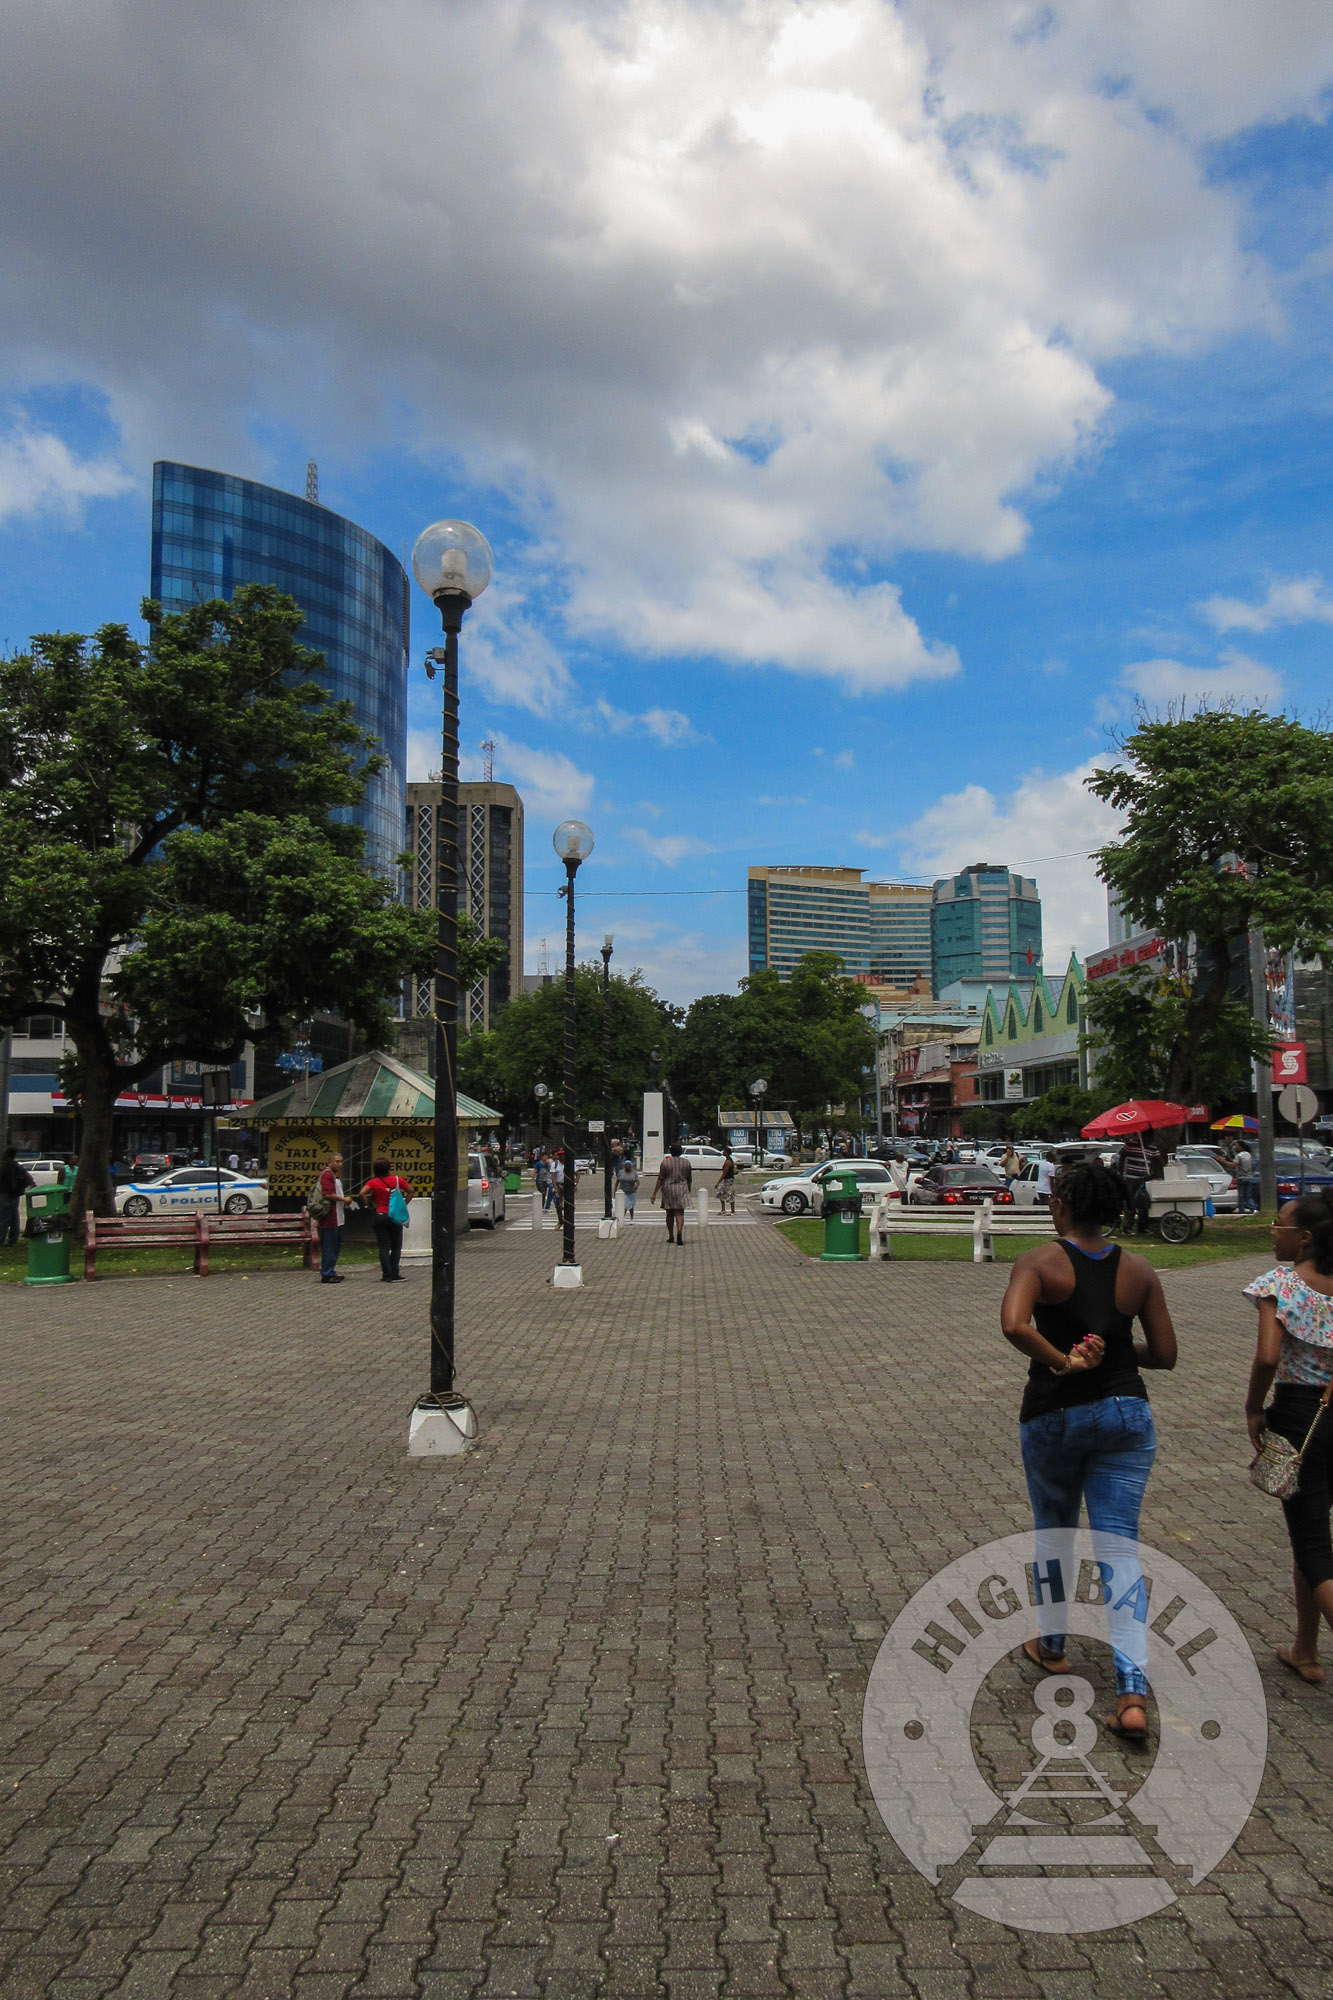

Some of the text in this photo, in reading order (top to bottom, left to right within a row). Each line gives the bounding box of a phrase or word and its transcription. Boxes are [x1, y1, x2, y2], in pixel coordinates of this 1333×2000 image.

[231, 1117, 249, 1128] 24
[285, 1117, 315, 1127] TAXI
[274, 1128, 333, 1153] BROADWAY
[286, 1148, 318, 1159] TAXI
[388, 1149, 421, 1159] TAXI
[274, 1161, 329, 1171] SERVIC
[389, 1161, 435, 1172] ERVICE
[171, 1196, 220, 1205] POLICE
